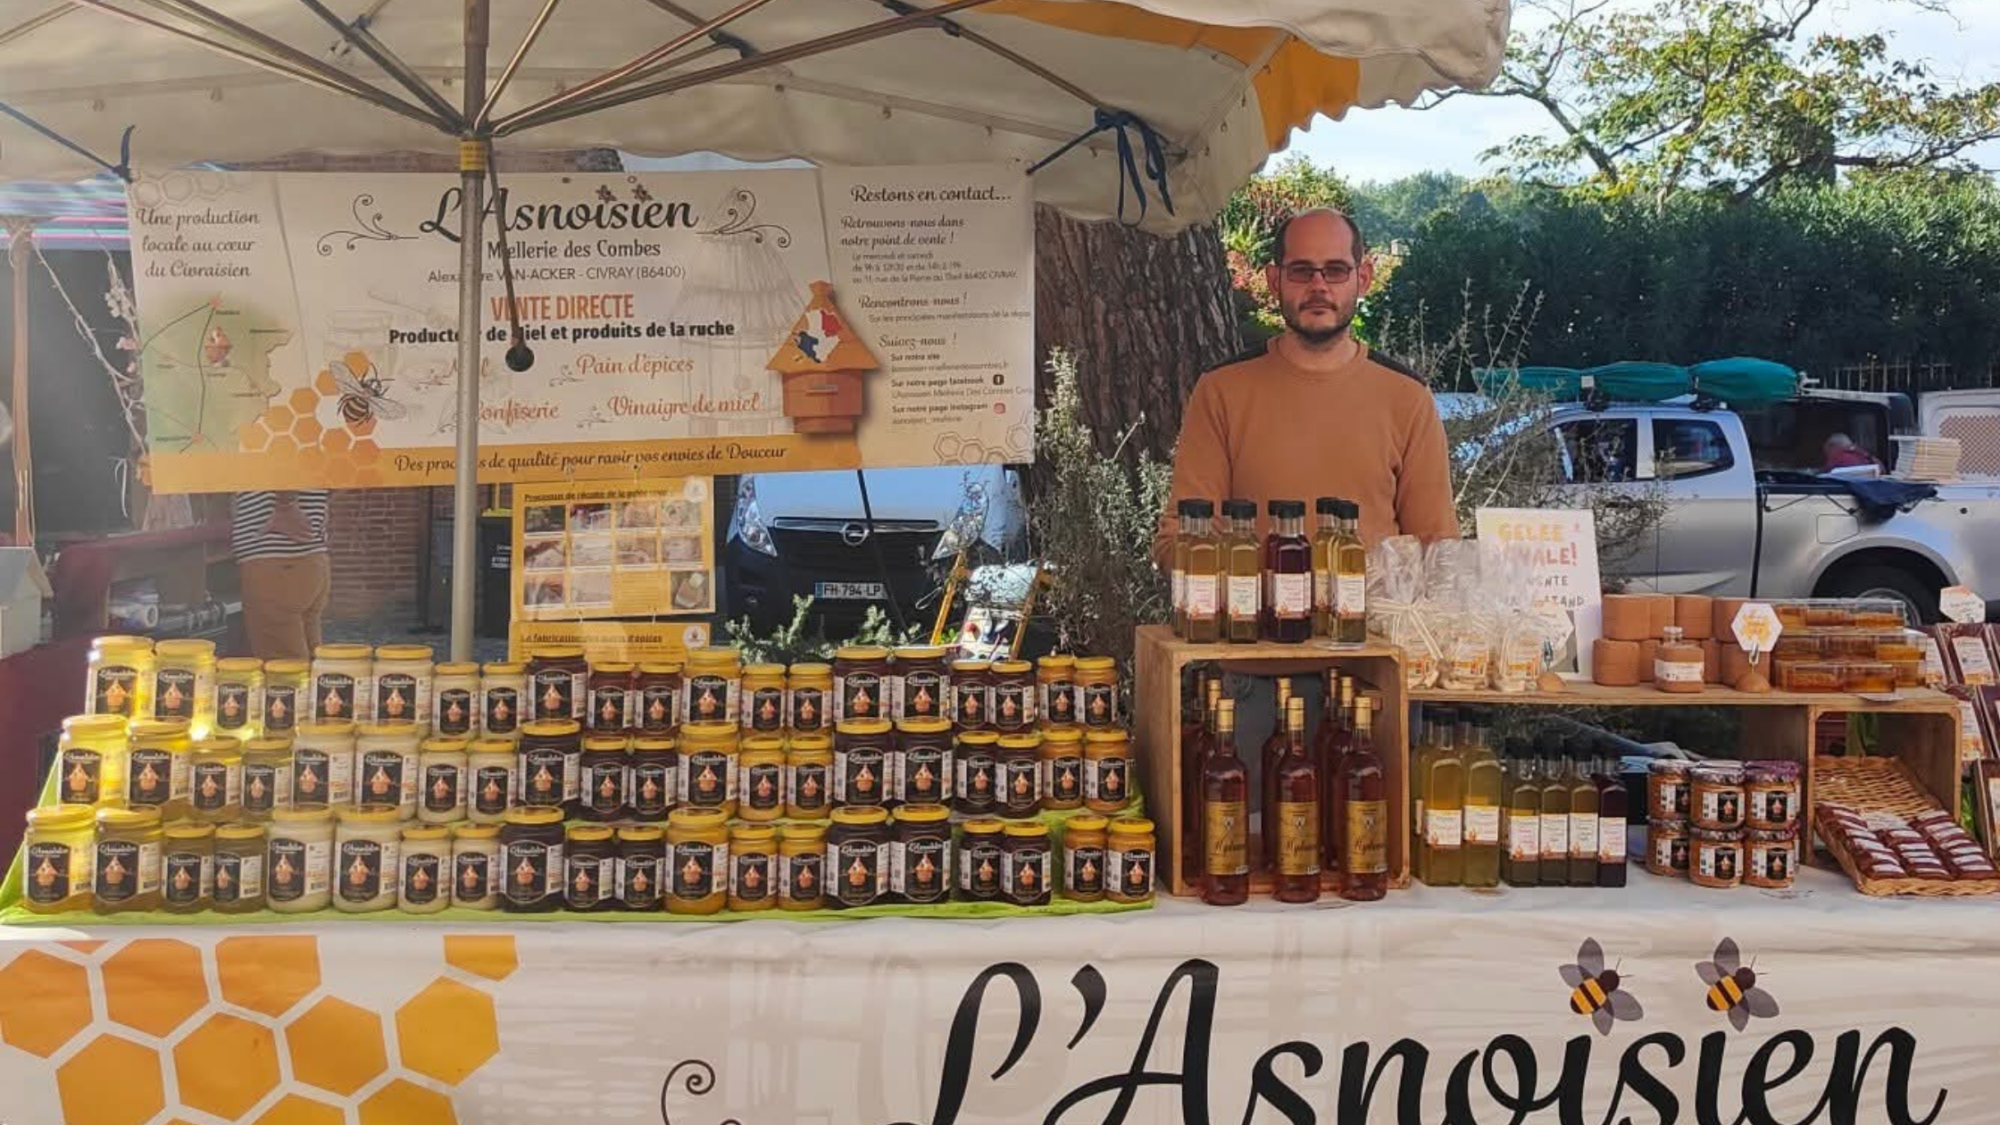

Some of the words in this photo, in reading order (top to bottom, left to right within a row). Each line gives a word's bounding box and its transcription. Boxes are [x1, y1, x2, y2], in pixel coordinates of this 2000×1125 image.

[850, 185, 913, 202] Restons
[918, 190, 935, 201] en
[136, 207, 172, 225] Une
[175, 207, 261, 231] production
[419, 186, 699, 243] LAsnoisien
[938, 214, 965, 228] dans
[142, 235, 188, 252] locale
[193, 241, 211, 251] au
[216, 241, 256, 252] cœur
[488, 240, 557, 259] Mellerie
[564, 241, 591, 258] des
[597, 239, 661, 257] Combes
[841, 235, 870, 246] notre
[872, 234, 901, 250] point
[903, 233, 916, 245] de
[918, 234, 947, 245] vente
[145, 260, 167, 277] du
[170, 260, 251, 277] Civraisien
[428, 271, 494, 284] Alexre
[586, 266, 634, 280] CIVRAY
[636, 265, 686, 280] (86400)
[556, 294, 635, 320] DIRECTE
[388, 327, 481, 345] Product
[486, 326, 507, 342] de
[551, 324, 568, 341] et
[571, 323, 643, 344] produits
[646, 322, 667, 339] de
[670, 321, 687, 338] la
[689, 320, 736, 337] ruche
[576, 353, 625, 375] Pain
[627, 352, 695, 379] d'épices
[478, 399, 560, 427] onfiserie
[607, 395, 694, 422] Vinaigre
[690, 394, 715, 412] de
[717, 391, 763, 411] miel
[394, 454, 424, 472] Des
[425, 456, 486, 478] pros
[488, 452, 506, 469] de
[507, 452, 558, 475] qualité
[561, 452, 595, 473] pour
[597, 450, 633, 466] ravir
[635, 451, 660, 465] vos
[662, 446, 704, 463] envies
[706, 444, 723, 460] de
[725, 442, 788, 461] Douceur
[824, 583, 881, 597] FH-794-LP
[888, 957, 1949, 1125] L'Asnoisien
